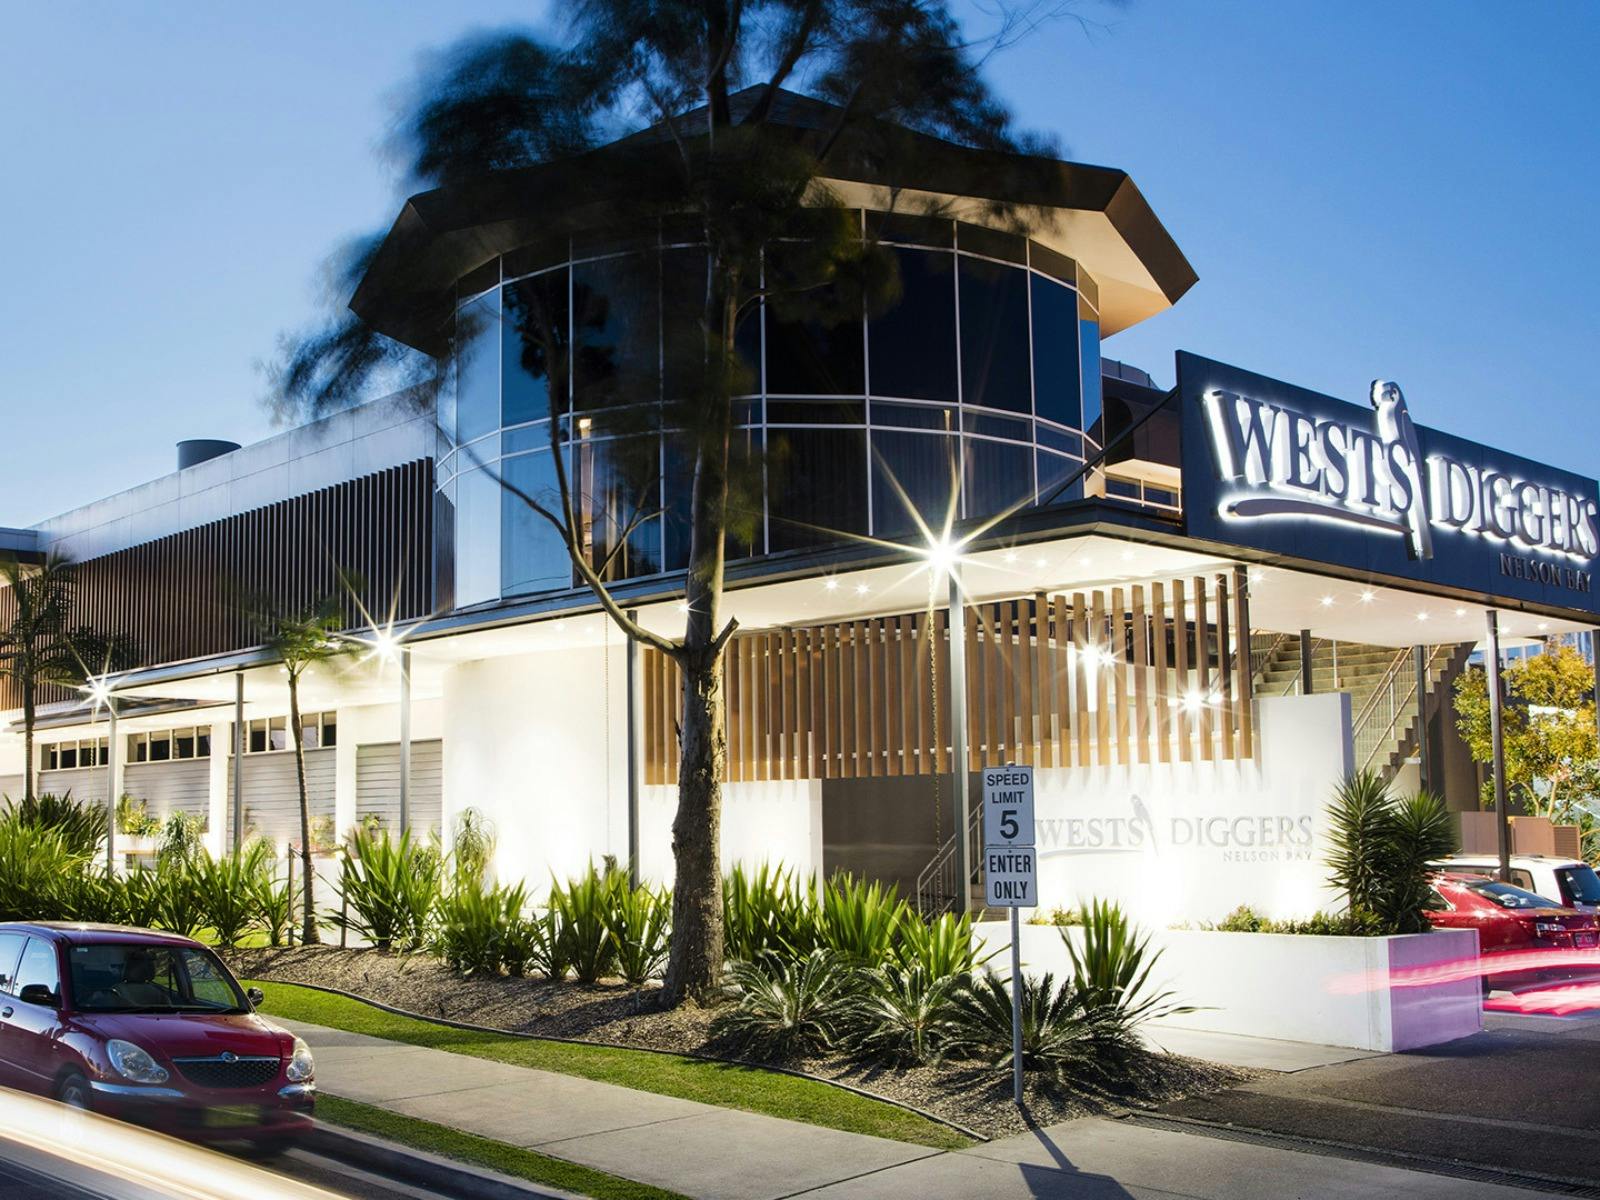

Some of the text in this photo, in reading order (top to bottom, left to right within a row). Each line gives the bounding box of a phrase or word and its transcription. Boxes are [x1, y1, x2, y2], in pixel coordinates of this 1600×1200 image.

[1204, 389, 1599, 562] WESTS DIGGERS
[1500, 552, 1592, 593] NELSON BAY
[987, 773, 1030, 787] SPEED
[991, 791, 1025, 804] LIMIT
[999, 809, 1019, 840] 5
[1036, 815, 1313, 848] WESTS DIGGERS
[989, 854, 1032, 873] ENTER
[1223, 850, 1312, 863] NELSON BAY
[993, 880, 1028, 900] ONLY
